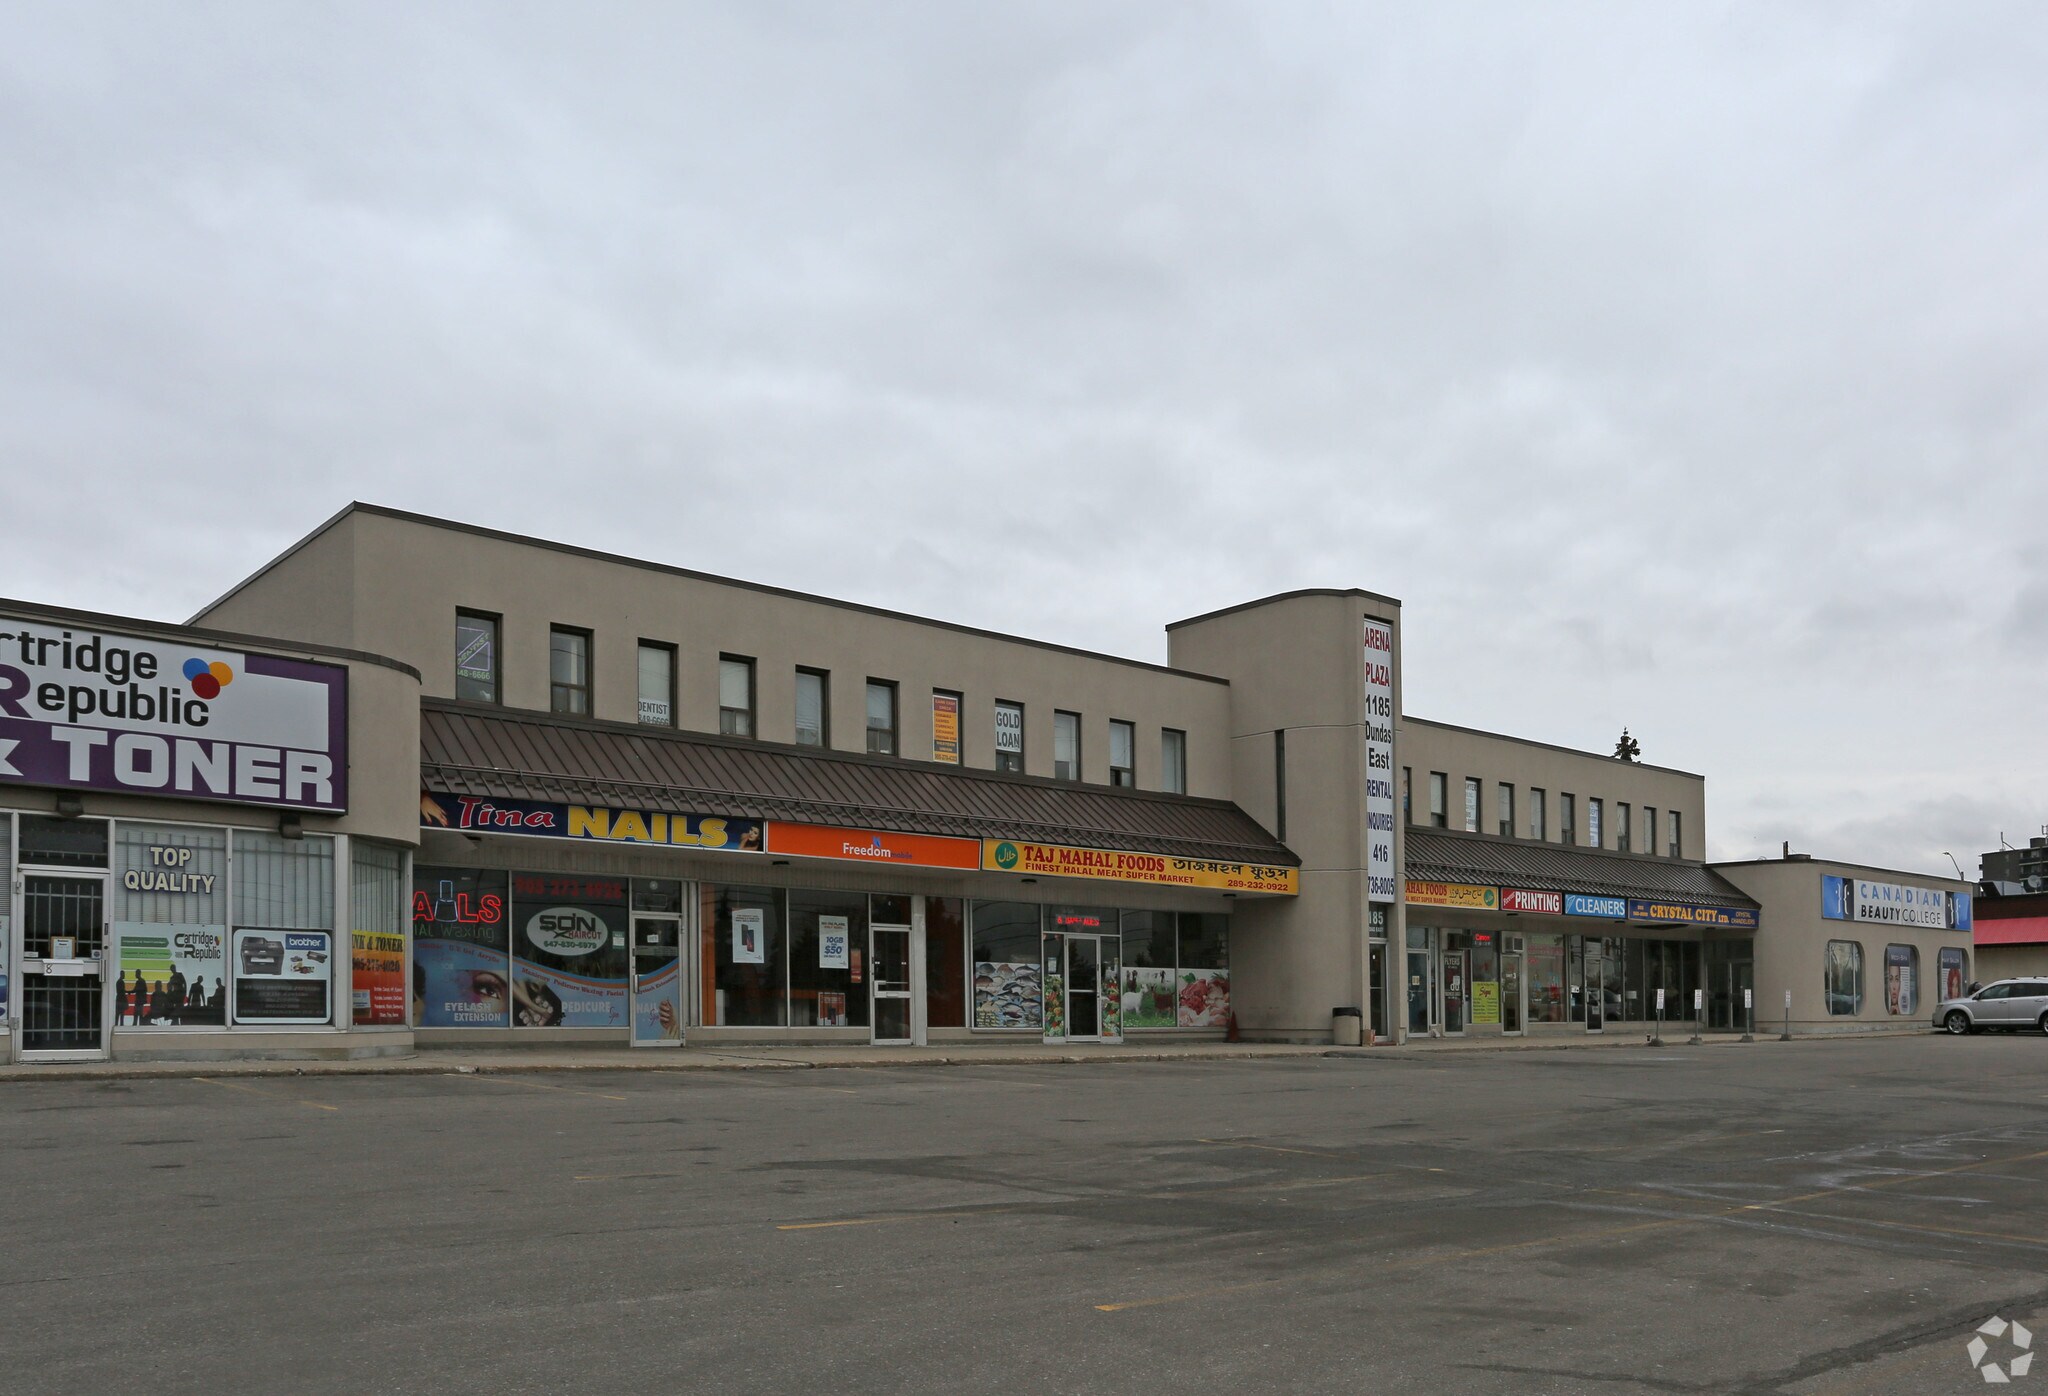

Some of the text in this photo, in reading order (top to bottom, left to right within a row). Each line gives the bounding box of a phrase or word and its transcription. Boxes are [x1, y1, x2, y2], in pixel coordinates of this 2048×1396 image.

[1364, 627, 1390, 653] ARENA
[1365, 661, 1390, 687] PLAZA
[0, 663, 209, 727] Republic
[638, 701, 667, 715] DENTIST
[1366, 694, 1390, 718] 1185
[996, 711, 1020, 729] GOLD
[996, 731, 1020, 749] LOAN
[1366, 720, 1392, 744] Dundas
[51, 725, 333, 804] TONER
[1369, 747, 1390, 770] East
[1366, 779, 1392, 800] RENTAL
[458, 797, 728, 847] Tina NAILS
[150, 845, 192, 867] TOP
[843, 842, 891, 858] Freedom
[1024, 845, 1165, 873] TAJ MAHAL FOODS
[1373, 845, 1388, 863] 416
[123, 869, 216, 894] QUALITY
[1025, 862, 1194, 884] FINEST HALAL MEAT SUPER MARKET
[1227, 879, 1289, 892] 289-232-0922
[1367, 877, 1394, 896] 736-8005
[1426, 884, 1448, 897] FOODS
[1515, 891, 1560, 912] PRINTING
[1861, 884, 1940, 906] CANADIAN
[1575, 898, 1626, 916] CLEANERS
[1650, 905, 1694, 920] CRYSTAL
[1695, 908, 1718, 923] CITY
[1861, 905, 1941, 924] BEAUTY COLLEGE
[174, 931, 213, 948] Cartridge
[289, 937, 321, 947] brother
[440, 923, 495, 943] Waxing
[568, 930, 601, 939] HAIRCUT
[826, 936, 844, 944] 10GB
[184, 944, 221, 962] Republic
[367, 936, 373, 950] &
[375, 937, 403, 952] TONER
[824, 946, 842, 954] $50
[46, 964, 52, 973] 8
[445, 1002, 493, 1012] EYELASH
[562, 1001, 612, 1013] PEDICURE
[453, 1012, 501, 1022] EXTENSION
